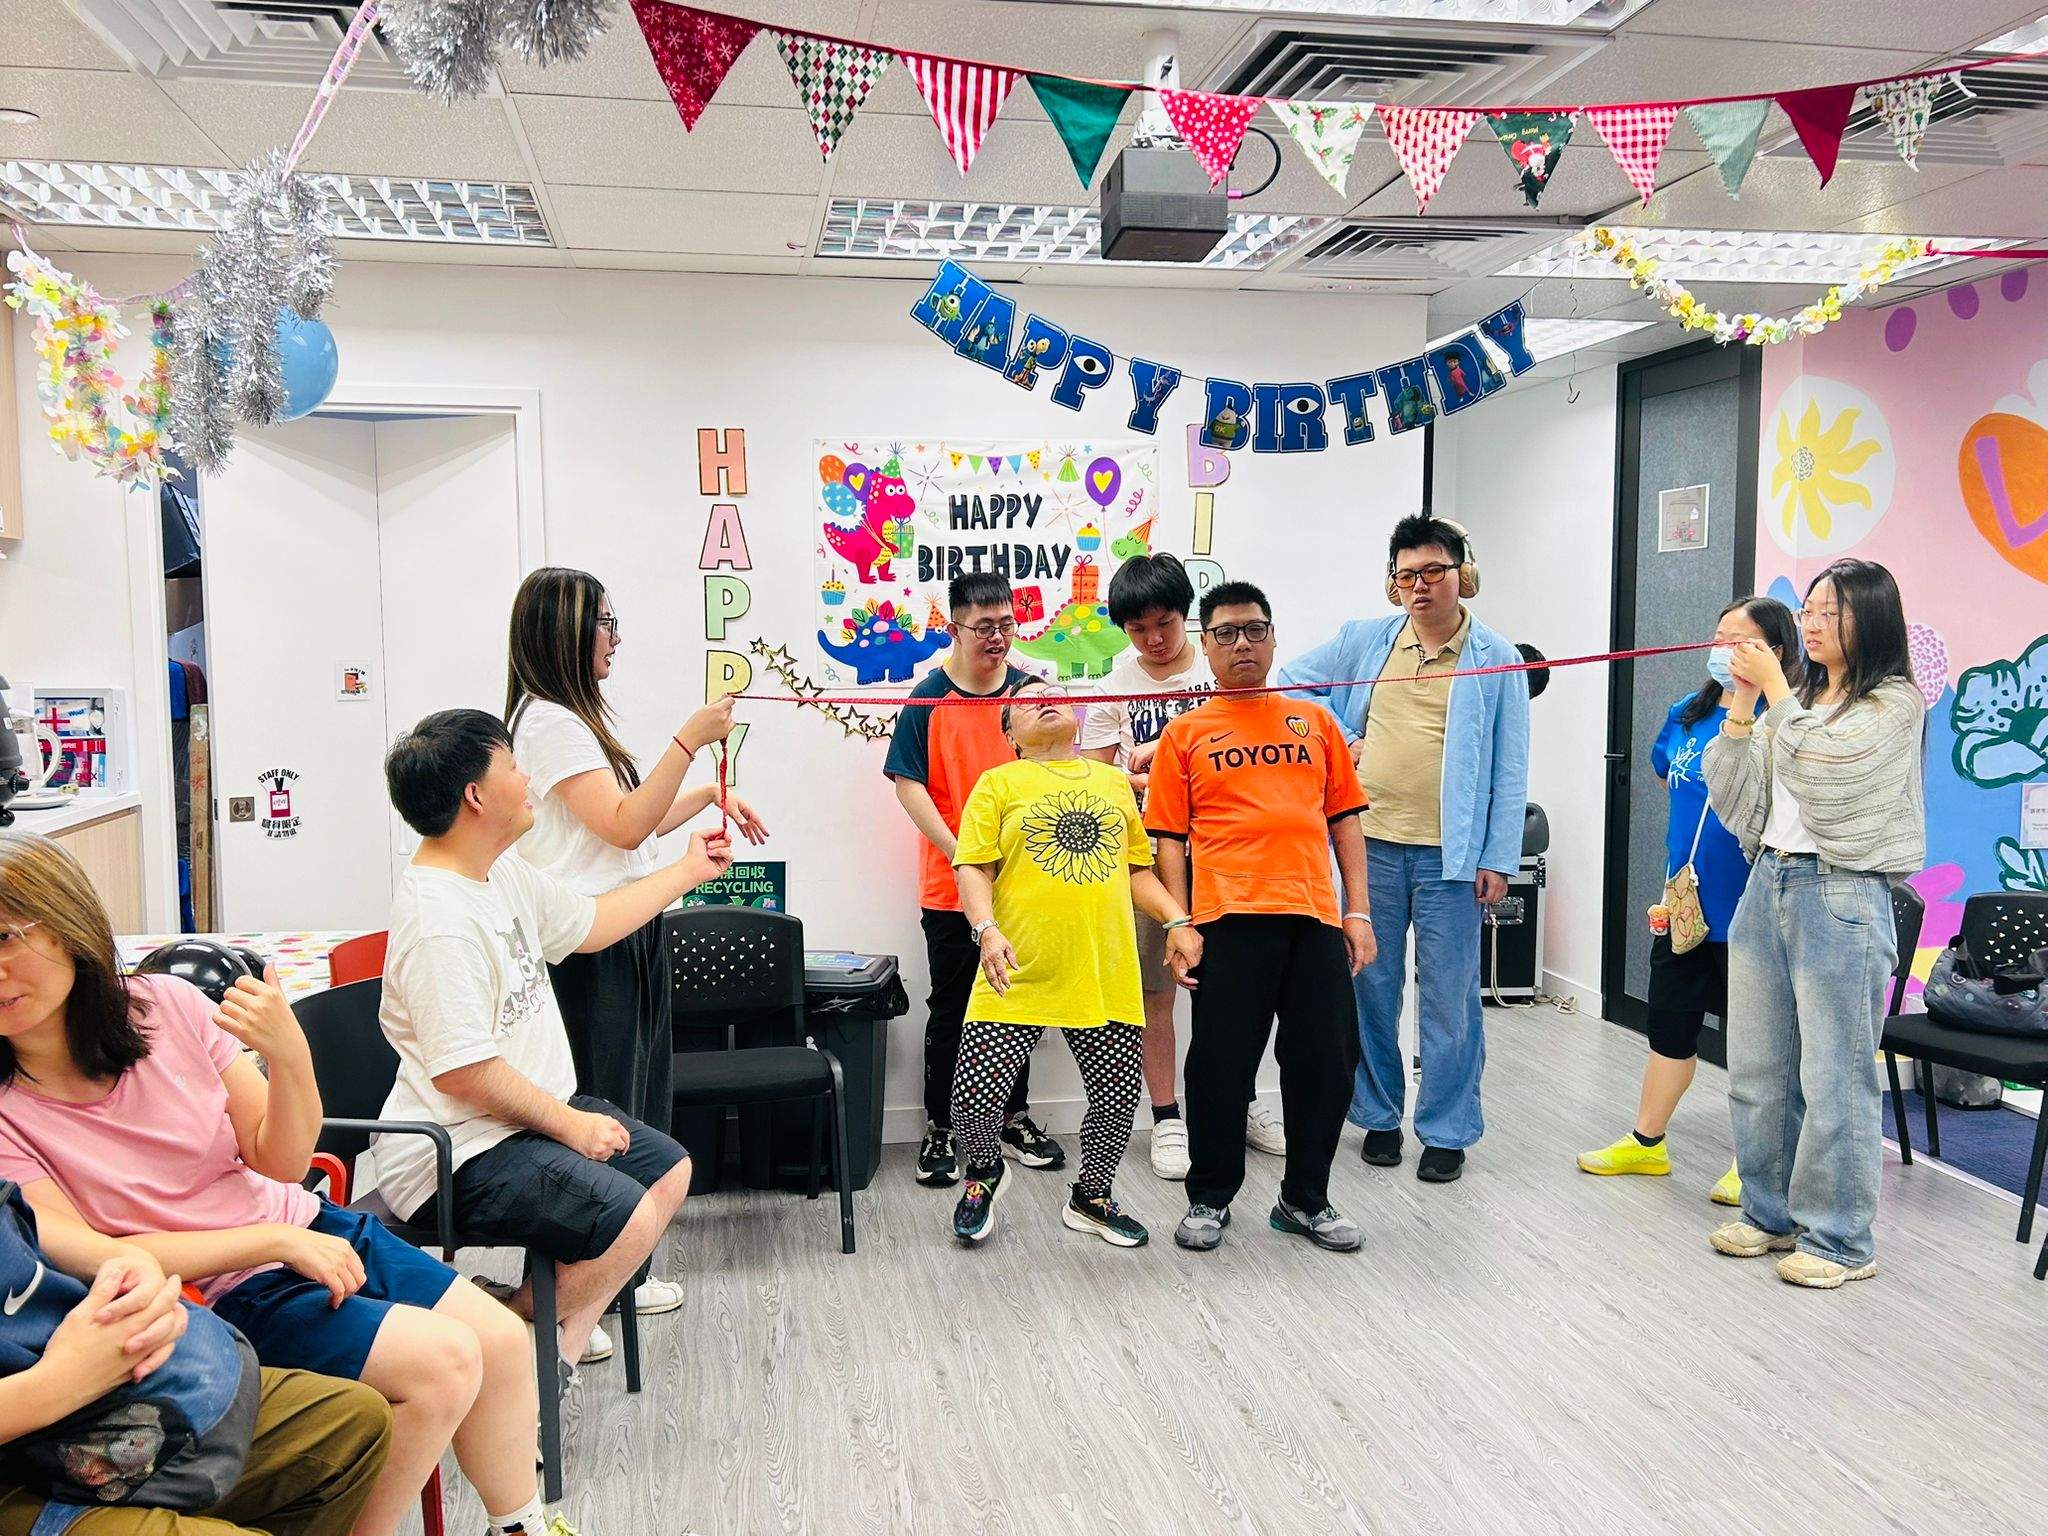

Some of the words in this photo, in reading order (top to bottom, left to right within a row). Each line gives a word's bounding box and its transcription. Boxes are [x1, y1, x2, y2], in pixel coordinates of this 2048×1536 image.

[910, 257, 1181, 435] HAPPY
[949, 493, 1043, 530] HAPPY
[918, 543, 1072, 582] BIRTHDAY
[697, 428, 753, 787] HAPPY
[257, 768, 279, 783] STAFF
[281, 768, 300, 781] ONLY
[1208, 743, 1313, 772] TOYOTA
[695, 881, 774, 894] RECYCLING
